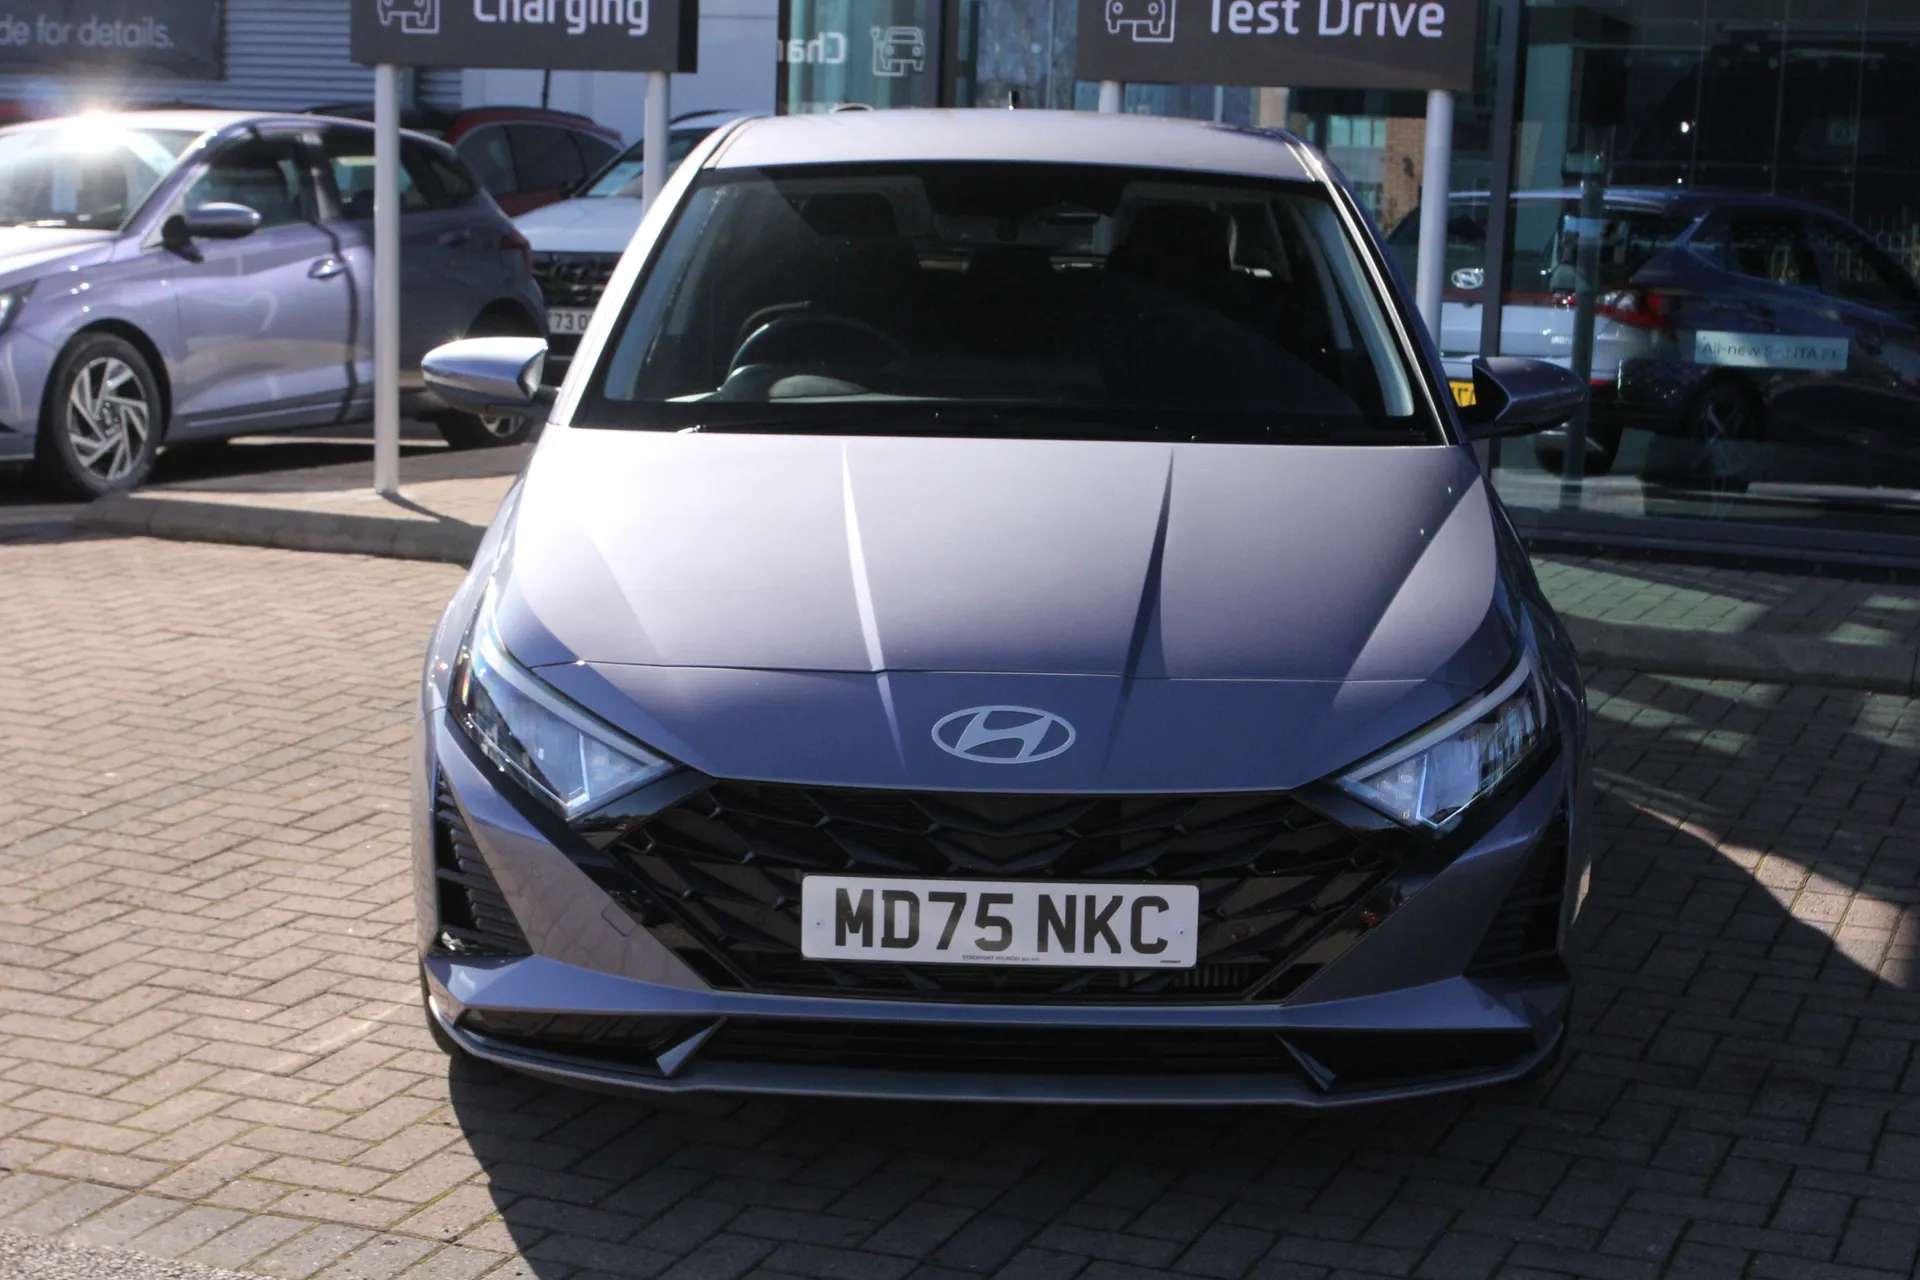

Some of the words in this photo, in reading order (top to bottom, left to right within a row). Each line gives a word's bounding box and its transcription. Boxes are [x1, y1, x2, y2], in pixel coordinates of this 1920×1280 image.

[36, 13, 72, 46] for
[77, 16, 175, 48] details.
[473, 0, 649, 36] Charging
[1211, 0, 1299, 34] Test
[1318, 0, 1445, 38] Drive
[835, 887, 1014, 952] MD75
[1037, 894, 1170, 954] NKC
